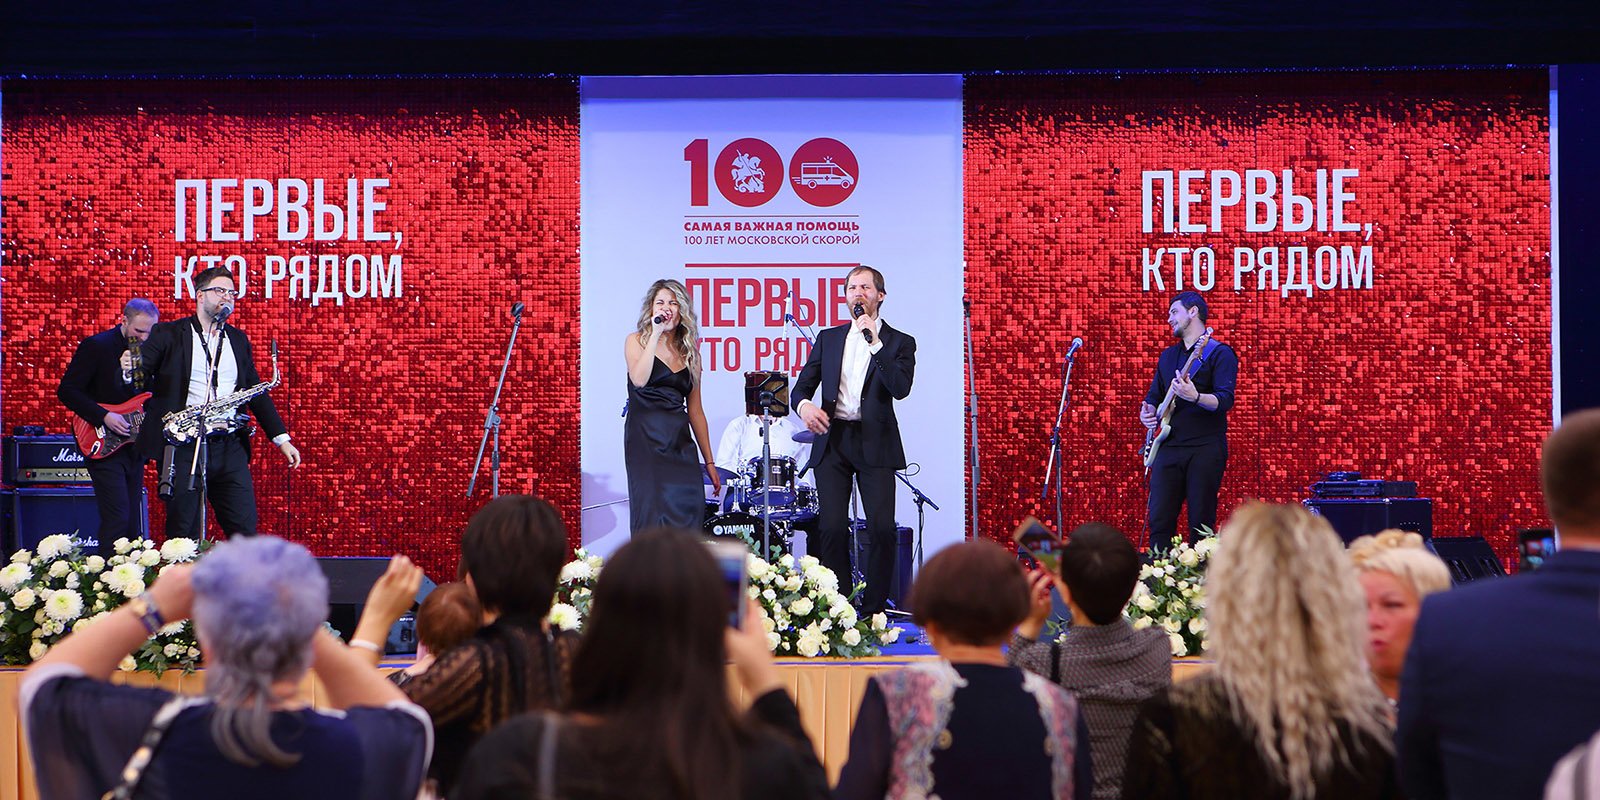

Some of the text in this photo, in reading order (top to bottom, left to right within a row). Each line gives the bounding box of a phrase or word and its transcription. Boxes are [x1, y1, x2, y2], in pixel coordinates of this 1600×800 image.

[175, 178, 403, 250] ПЕРВЫЕ,
[684, 222, 860, 232] САМАЯ ВАЖНАЯ ПОМОЩЬ
[1142, 168, 1373, 241] ПЕРВЫЕ,
[684, 233, 860, 245] 100 ЛЕТ МОСКОВСКОЙ СКОРОЙ
[265, 254, 403, 306] РЯДОМ
[1142, 245, 1373, 298] КТО РЯДОМ
[698, 337, 814, 377] ТО РЯД
[52, 448, 84, 462] Mars
